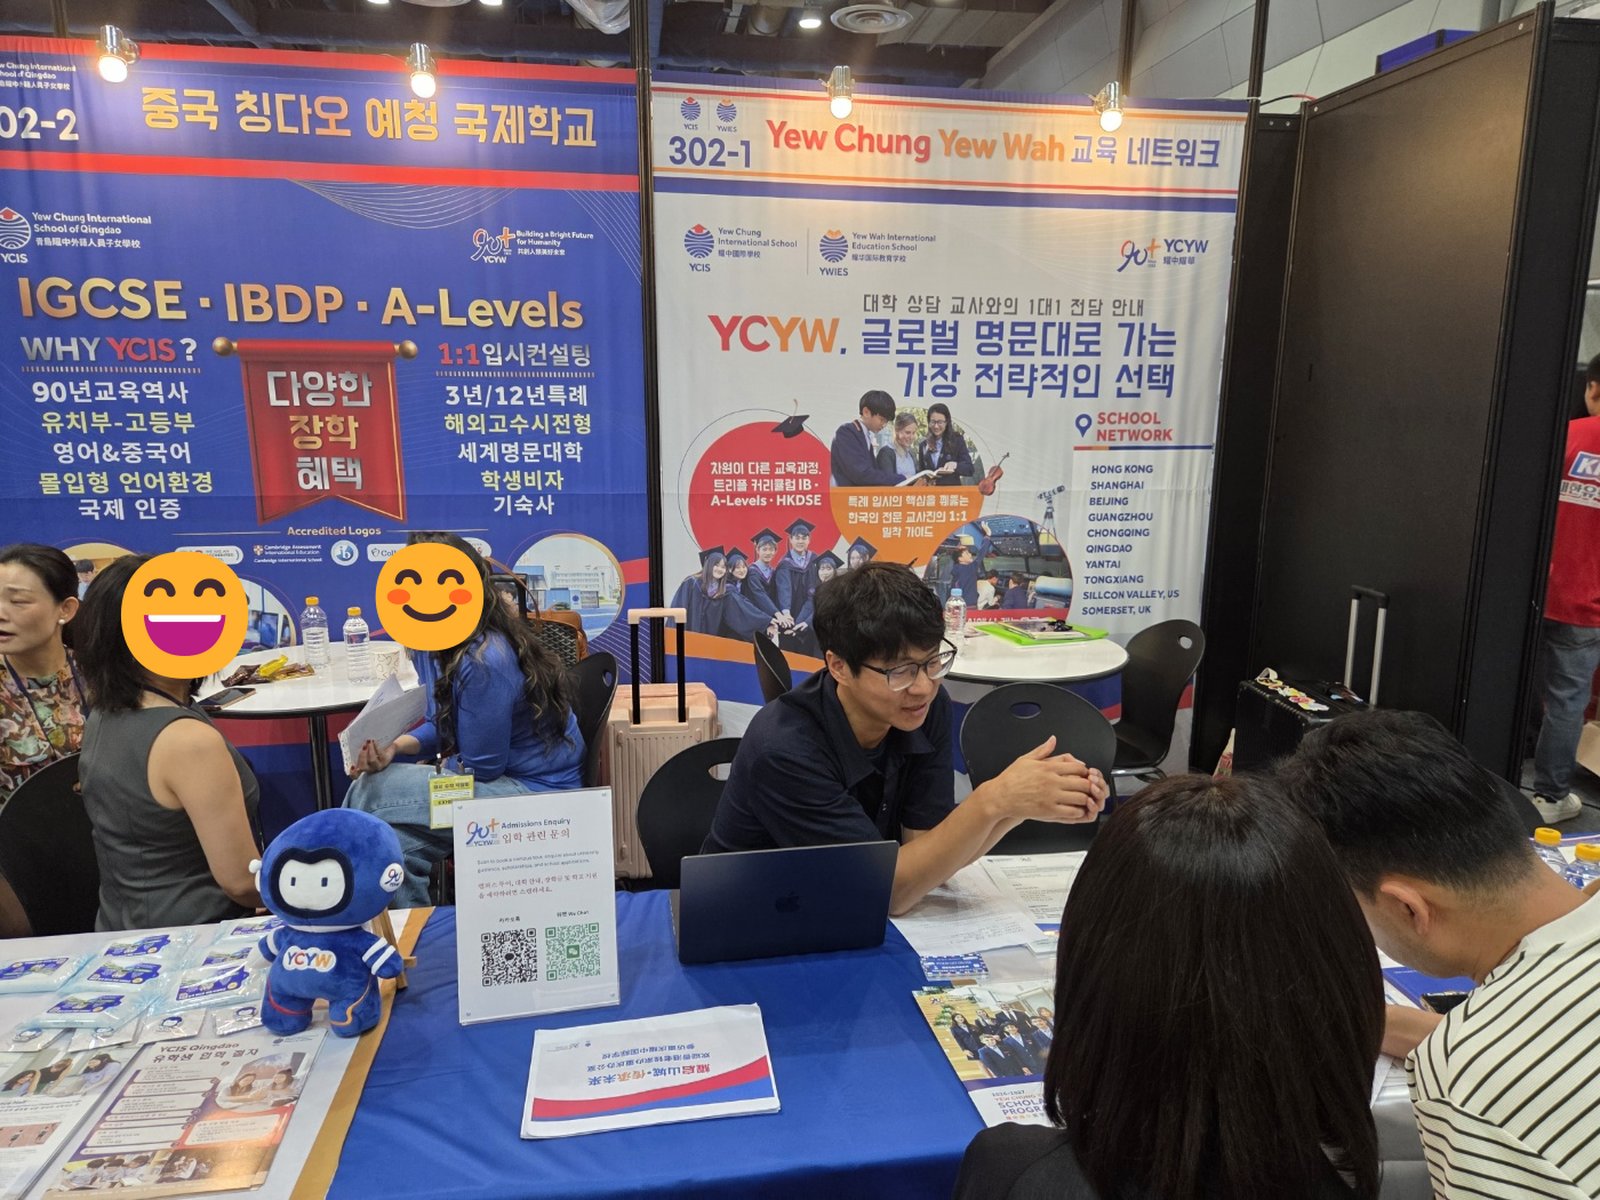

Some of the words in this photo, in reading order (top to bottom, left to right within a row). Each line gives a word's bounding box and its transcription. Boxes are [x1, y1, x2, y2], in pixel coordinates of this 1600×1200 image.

[141, 87, 219, 131] 중국
[235, 90, 352, 137] 칭다오
[365, 97, 439, 141] 예청
[454, 103, 597, 147] 국제학교
[683, 123, 699, 131] YCIS
[717, 125, 737, 133] YWIES
[766, 119, 827, 150] Yew
[834, 122, 932, 164] Chung
[938, 128, 998, 160] Yew
[1002, 131, 1065, 163] Wah
[1070, 134, 1118, 165] 교육
[1127, 136, 1221, 168] 네트워크
[668, 136, 751, 169] 302-1
[32, 212, 52, 221] Yew
[53, 213, 86, 224] Chung
[86, 213, 152, 224] International
[34, 224, 68, 233] School
[69, 224, 80, 233] of
[80, 225, 122, 236] Qingdao
[572, 231, 594, 239] Future
[718, 227, 734, 236] Yew
[735, 227, 762, 238] Chung
[852, 232, 867, 240] Yew
[868, 232, 886, 241] Wah
[887, 233, 937, 242] International
[718, 237, 770, 247] International
[770, 239, 798, 248] School
[852, 242, 890, 251] Education
[891, 243, 918, 252] School
[1163, 238, 1209, 254] YCYW
[1, 253, 28, 264] YCIS
[482, 256, 507, 264] YCYW
[689, 262, 711, 273] YCIS
[819, 266, 849, 277] YWIES
[18, 276, 188, 320] IGCSE
[224, 283, 344, 324] IBDP
[381, 287, 584, 329] A-Levels
[863, 294, 898, 314] 대학
[907, 295, 941, 315] 상담
[950, 296, 1019, 316] 교사와의
[1029, 298, 1061, 317] 1대1
[1070, 298, 1104, 317] 전담
[1112, 299, 1144, 318] 안내
[861, 318, 959, 357] 글로벌
[975, 320, 1102, 358] 명문대로
[1117, 322, 1177, 358] 가는
[20, 336, 101, 362] WHY
[896, 362, 961, 399] 가장
[974, 363, 1101, 399] 전략적인
[1115, 364, 1175, 399] 선택
[32, 379, 189, 405] 90년교육역사
[266, 370, 373, 407] 다양한
[445, 384, 588, 408] 3년/12년특례
[41, 411, 196, 435] 유치부-고등부
[444, 413, 592, 435] 해외고수시전형
[1097, 411, 1161, 425] SCHOOL
[289, 414, 359, 450] 장학
[1096, 428, 1173, 443] NETWORK
[53, 441, 192, 465] 영어&중국어
[457, 441, 583, 464] 세계명문대학
[296, 456, 363, 491] 혜택
[710, 461, 744, 475] 차원이
[748, 461, 771, 475] 다른
[1091, 464, 1122, 474] HONG
[1124, 464, 1154, 474] KONG
[38, 471, 110, 495] 몰입형
[119, 471, 213, 494] 언어환경
[480, 469, 564, 491] 학생비자
[713, 478, 748, 492] 트리플
[751, 478, 796, 492] 커리큘럼
[798, 478, 812, 491] IB
[1090, 480, 1145, 490] SHANGHAI
[493, 494, 555, 516] 기숙사
[710, 494, 767, 506] A-Levels
[776, 494, 822, 506] HKDSE
[872, 495, 903, 508] 입시의
[905, 494, 936, 507] 핵심을
[1089, 496, 1129, 506] BEIJING
[78, 498, 125, 521] 국제
[135, 497, 182, 520] 인증
[848, 511, 879, 524] 한국인
[882, 511, 903, 524] 전문
[905, 510, 946, 524] 교사진의
[949, 510, 968, 522] 1:1
[1088, 512, 1154, 522] GUANGZHOU
[287, 526, 347, 537] Accredited
[348, 526, 382, 538] Logos
[882, 526, 902, 539] 밀착
[906, 526, 934, 538] 가이드
[1087, 528, 1150, 538] CHONGQING
[1086, 544, 1133, 554] QINGDAO
[1085, 560, 1121, 570] YANTAI
[1084, 575, 1144, 584] TONGXIANG
[1126, 590, 1166, 600] VALLEY,
[1167, 589, 1180, 598] US
[1082, 606, 1136, 616] SOMERSET,
[1138, 605, 1152, 614] UK
[501, 820, 542, 830] Admissions
[544, 818, 571, 827] Enquiry
[502, 832, 522, 844] 입학
[526, 830, 547, 842] 관련
[550, 828, 571, 840] 문의
[286, 951, 332, 968] YCYW
[160, 1045, 188, 1053] YCIS
[189, 1043, 240, 1052] Qingdao
[153, 1054, 194, 1064] 유학생
[200, 1050, 227, 1060] 입학
